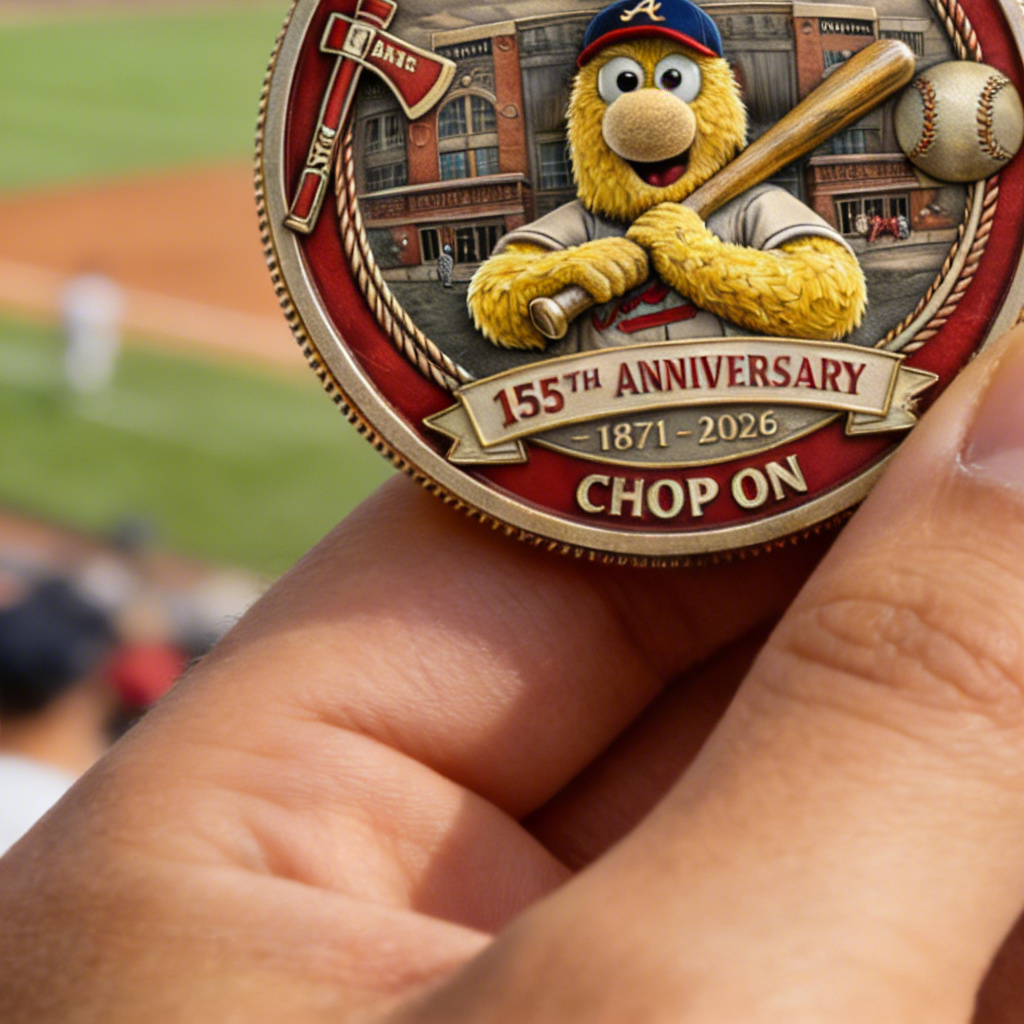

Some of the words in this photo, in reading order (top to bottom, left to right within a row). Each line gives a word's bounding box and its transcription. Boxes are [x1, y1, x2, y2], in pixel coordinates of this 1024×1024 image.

[491, 367, 601, 429] 155TH
[614, 355, 867, 398] ANNIVERSARY
[598, 421, 669, 453] 1871
[698, 410, 778, 445] 2026
[575, 473, 719, 520] CHOP
[731, 453, 809, 510] ON
